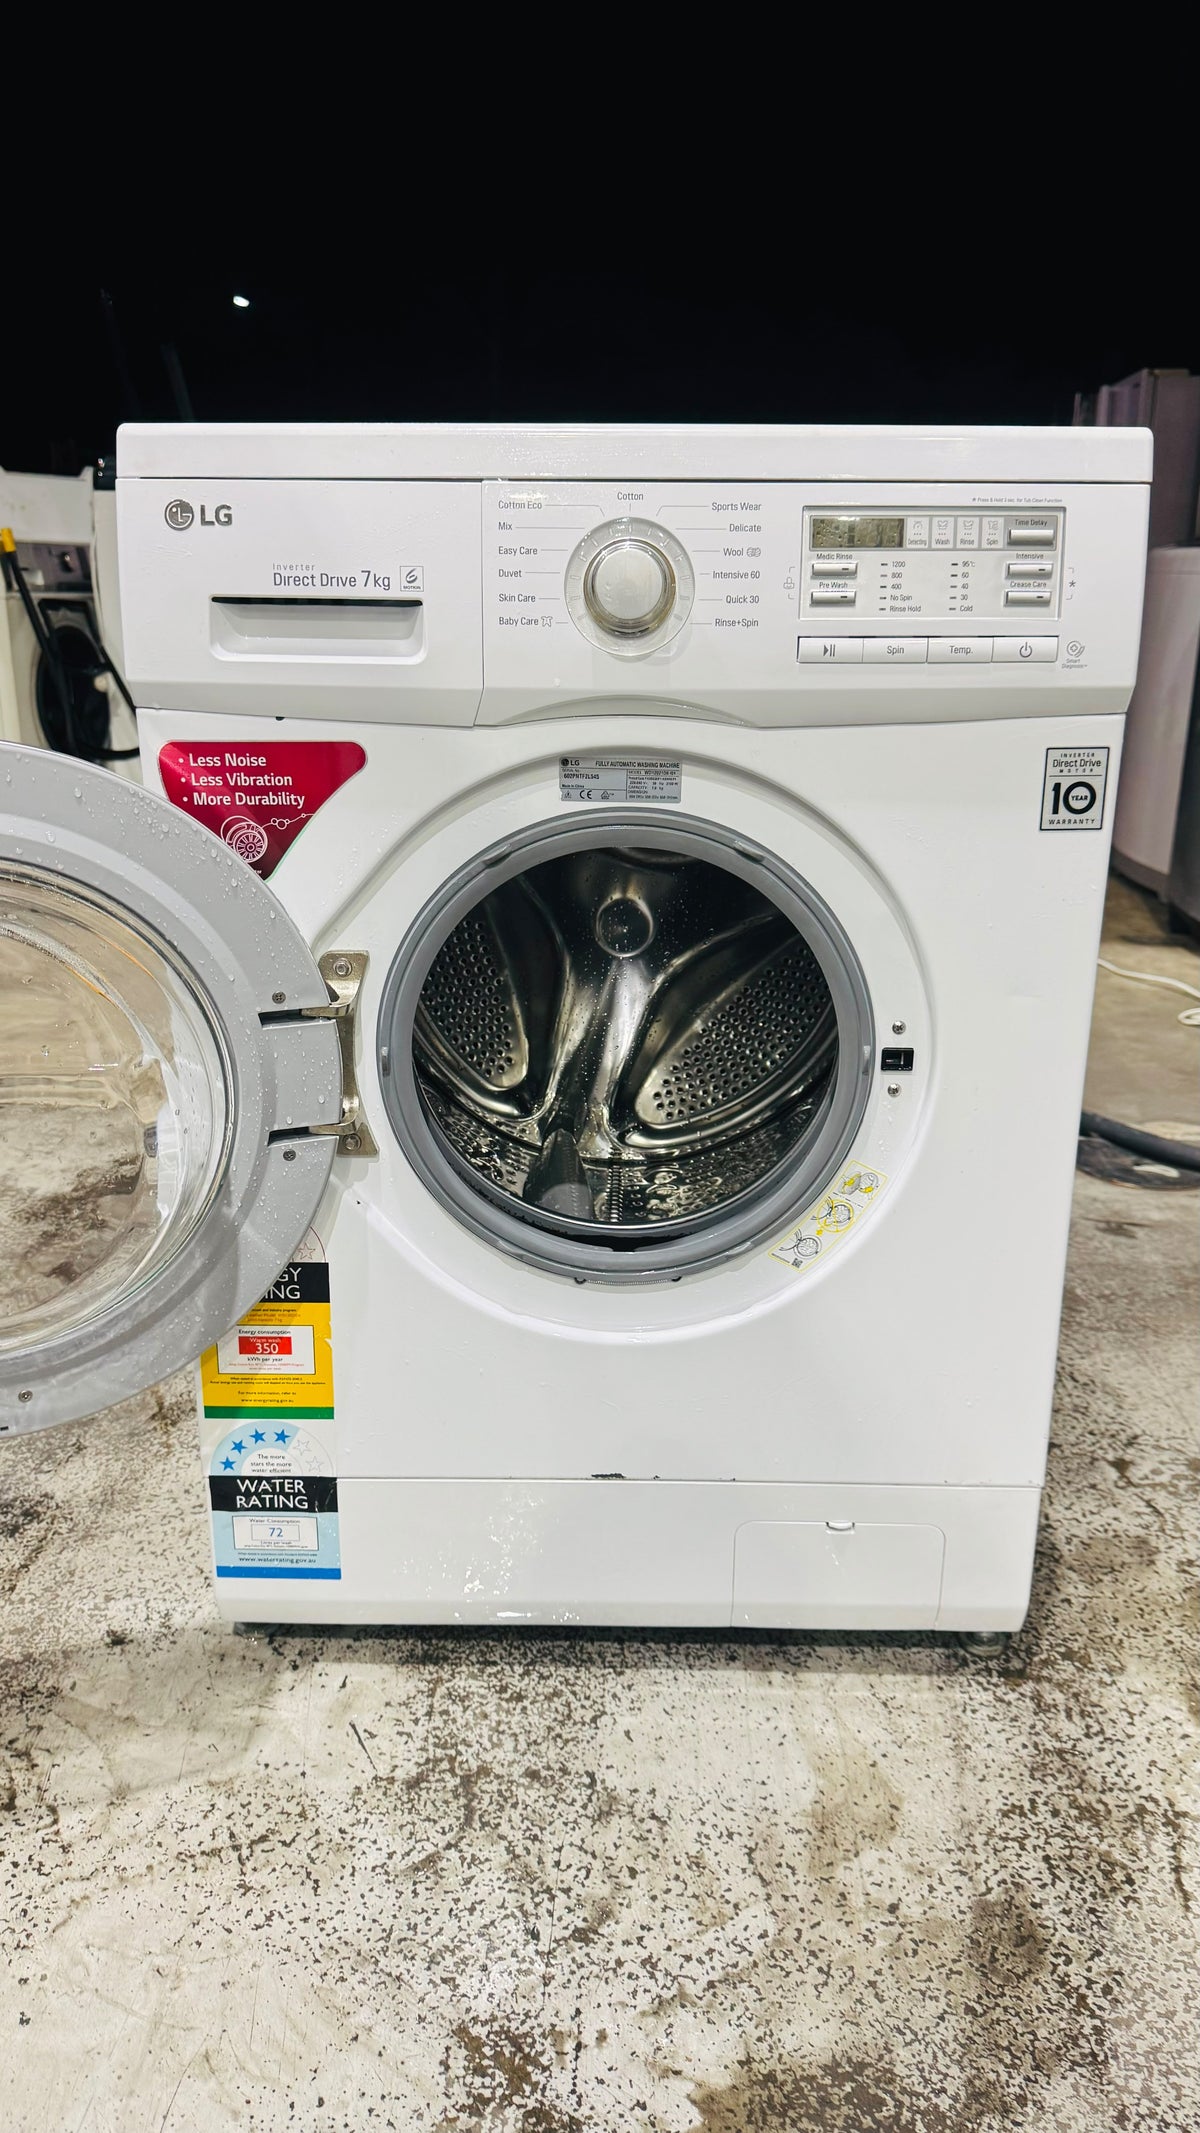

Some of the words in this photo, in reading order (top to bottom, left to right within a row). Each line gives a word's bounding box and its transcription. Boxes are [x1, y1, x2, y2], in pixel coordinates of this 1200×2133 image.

[617, 492, 644, 501] Cotton
[498, 501, 526, 510] Cotton
[527, 501, 543, 510] Eco
[711, 502, 738, 513] Sports
[739, 502, 762, 511] Wear
[200, 504, 233, 526] LG
[498, 522, 513, 531] Mix
[729, 523, 762, 533] Delicate
[1030, 519, 1048, 527] Delay
[986, 538, 998, 546] Spin
[498, 546, 518, 556] Easy
[519, 546, 538, 555] Care
[723, 547, 744, 557] Wool
[273, 563, 315, 571] Inverter
[498, 569, 522, 578] Duvet
[712, 570, 750, 579] Intensive
[750, 570, 761, 579] 60
[273, 572, 316, 587] Direct
[320, 572, 357, 588] Drive
[498, 594, 516, 603] Skin
[517, 594, 536, 603] Care
[726, 595, 748, 604] Quick
[749, 595, 760, 604] 30
[900, 594, 912, 602] Spin
[498, 617, 519, 627] Baby
[520, 617, 539, 626] Care
[715, 618, 759, 628] Rinse+Spin
[886, 645, 905, 655] Spin
[949, 645, 974, 656] Temp.
[189, 753, 221, 767] Less
[225, 753, 267, 767] Noise
[1052, 758, 1078, 768] Direct
[1079, 758, 1102, 767] Drive
[191, 772, 223, 787] Less
[226, 772, 293, 786] Vibration
[194, 792, 231, 806] More
[236, 792, 305, 809] Durability
[1052, 781, 1097, 815] 10
[238, 1328, 257, 1336] Energy
[255, 1343, 279, 1354] 350
[236, 1479, 307, 1494] WATER
[236, 1495, 308, 1510] RATING
[268, 1527, 284, 1538] 72
